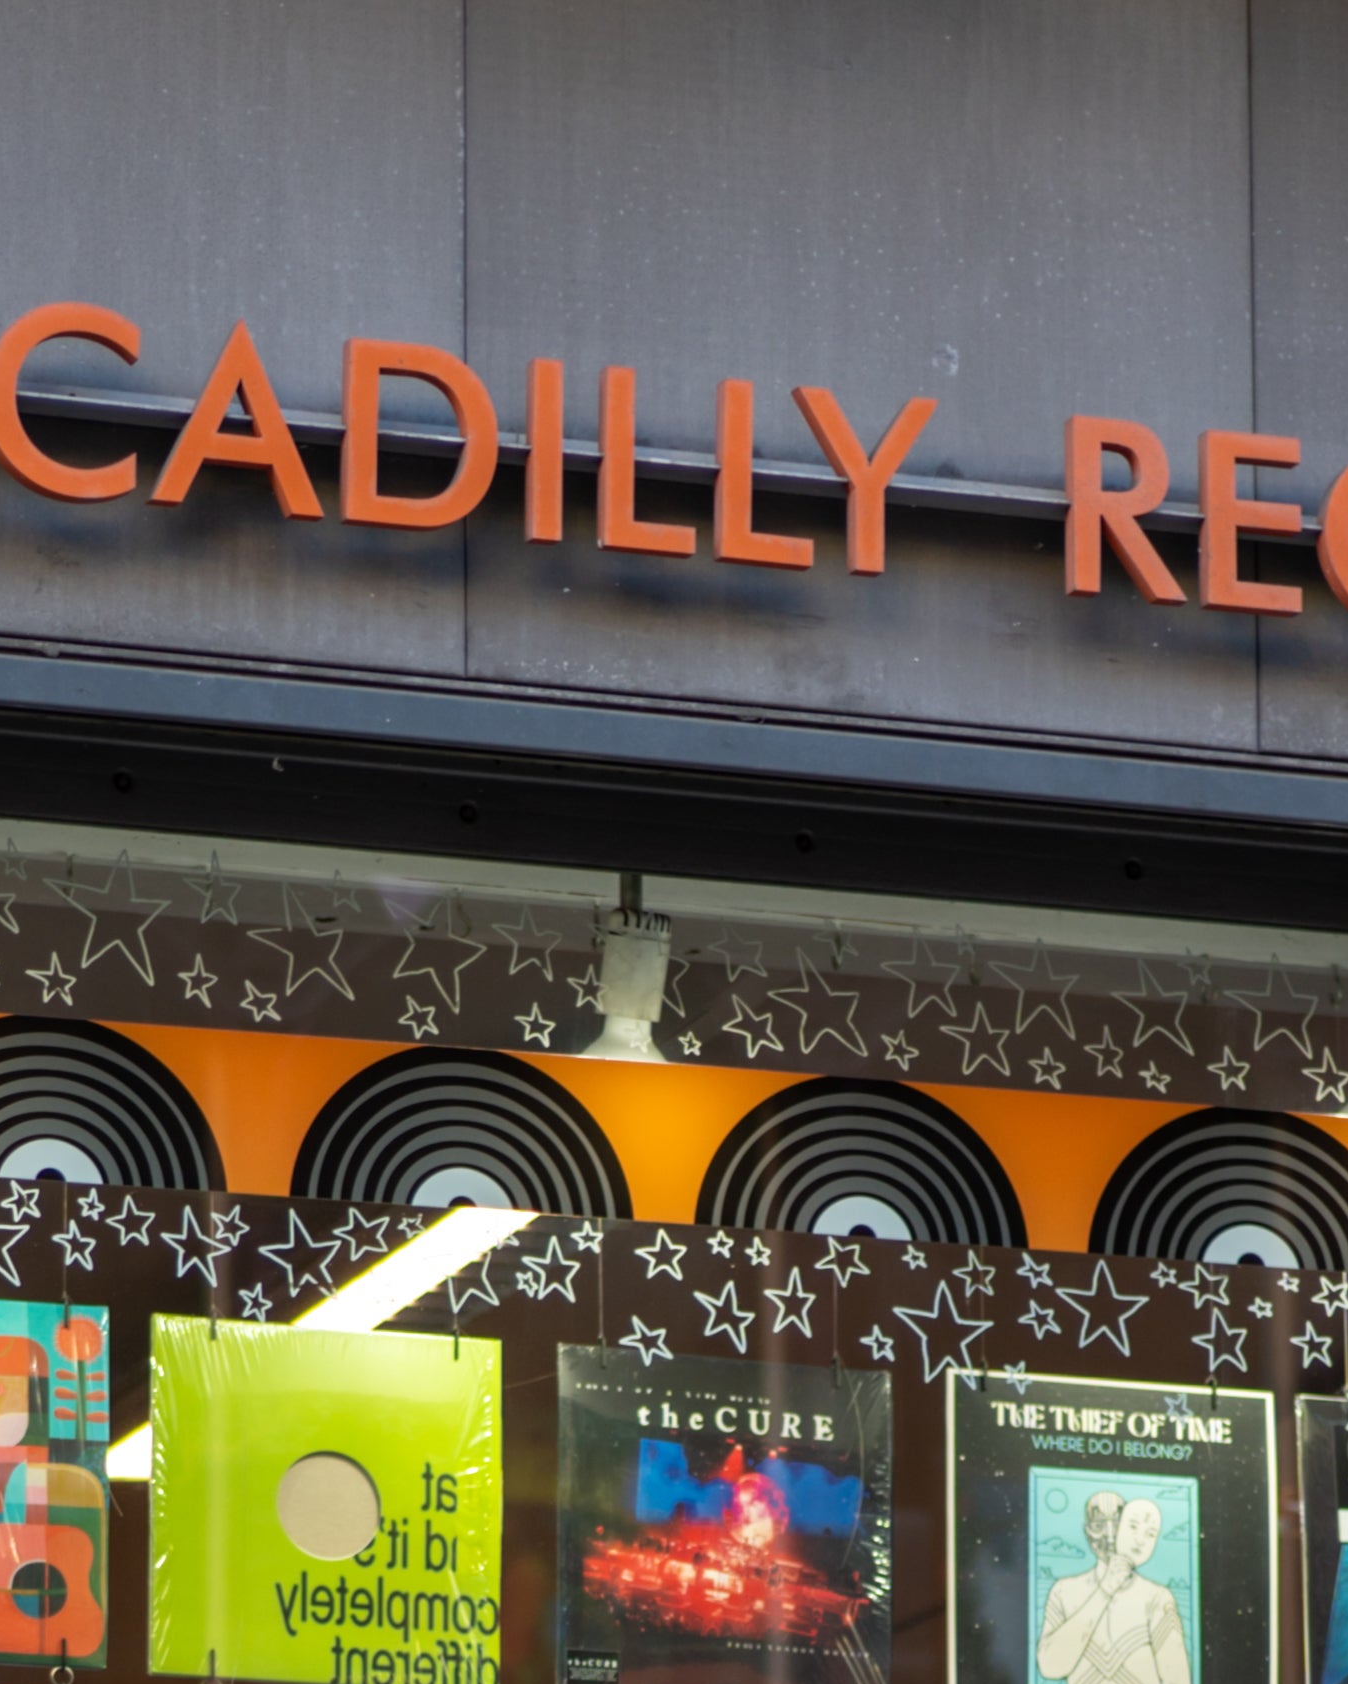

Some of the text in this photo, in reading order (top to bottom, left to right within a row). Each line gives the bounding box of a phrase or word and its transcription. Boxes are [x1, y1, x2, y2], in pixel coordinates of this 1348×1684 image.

[991, 1401, 1233, 1444] THE THIEF OF TIME
[1032, 1434, 1085, 1454] WHERE
[1088, 1438, 1112, 1455] DO
[1123, 1440, 1193, 1461] BELONG?
